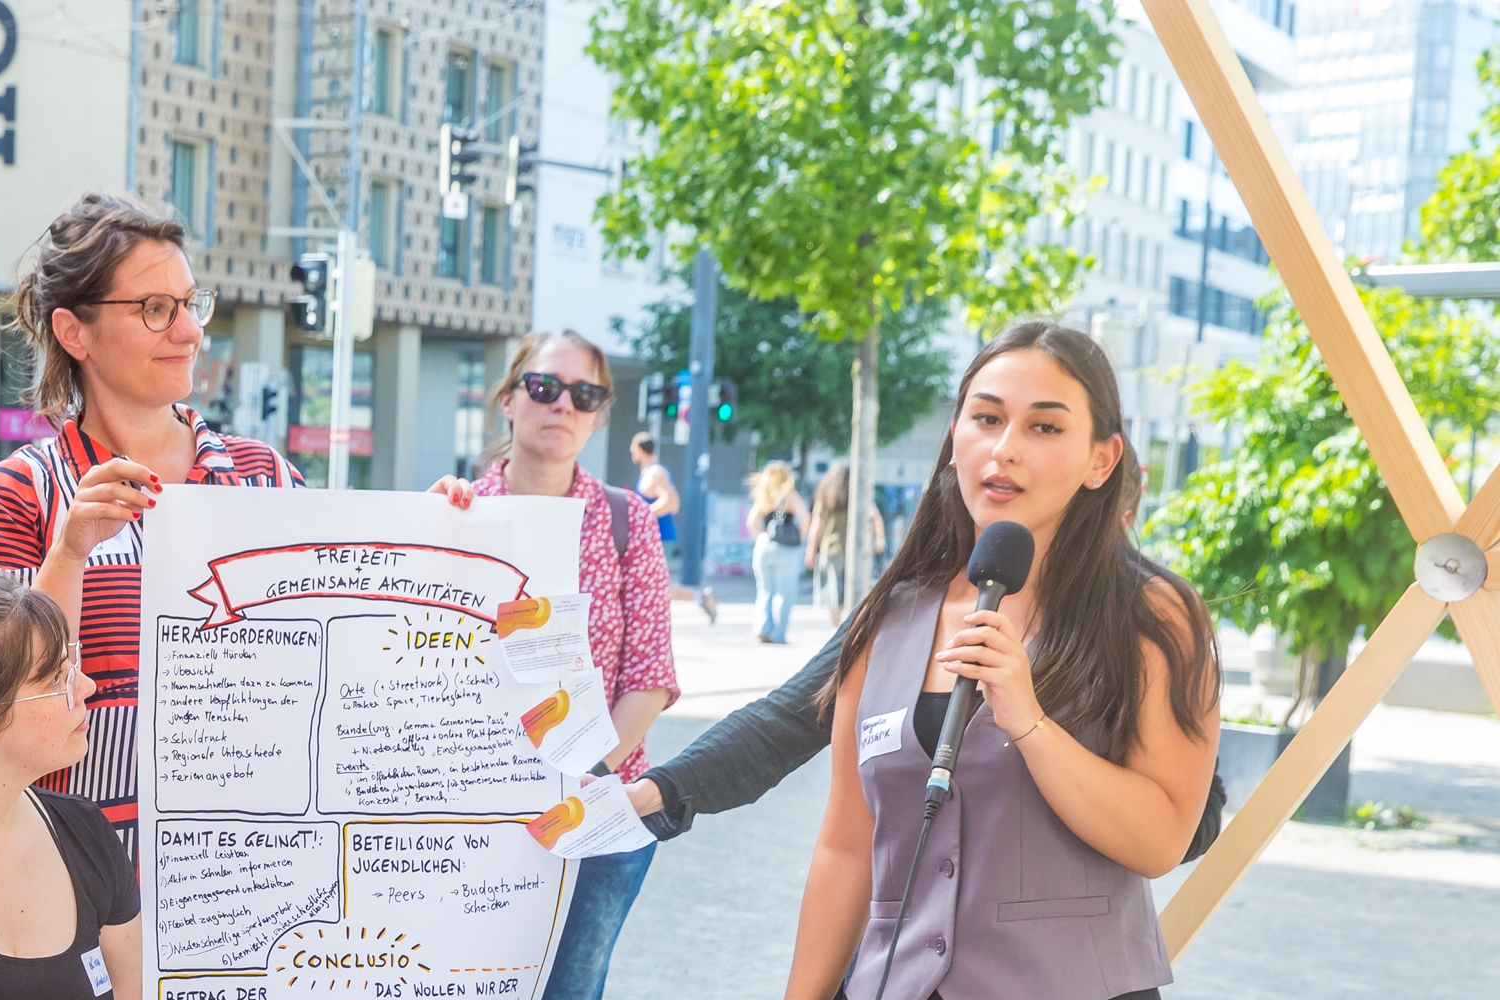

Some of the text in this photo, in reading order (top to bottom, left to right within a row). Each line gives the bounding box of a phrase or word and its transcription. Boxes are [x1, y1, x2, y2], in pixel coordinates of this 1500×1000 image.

[314, 547, 407, 567] FREIZEIT
[266, 575, 486, 608] GEMEINSAME AKTIVITÄTEN
[161, 624, 321, 647] HERAUSFORDERUNGEN:
[407, 630, 475, 651] IDEEN
[280, 676, 314, 688] kommen
[339, 682, 366, 697] Orte
[170, 694, 204, 707] andere
[280, 694, 299, 706] der
[205, 708, 250, 723] Menschen
[170, 728, 228, 745] Schuldruck
[171, 743, 283, 767] Regionale Unterschiede
[171, 762, 254, 787] Ferienangebote
[161, 830, 214, 848] DAMIT
[218, 831, 238, 848] ES
[352, 833, 490, 852] BETEILIGUNG VON
[200, 864, 233, 880] Schulen
[238, 858, 293, 877] informieren
[388, 886, 426, 904] Peers
[461, 877, 512, 902] Budgets
[199, 904, 252, 927] zugänglich
[374, 977, 519, 998] DAS WOLLEN WIR DER
